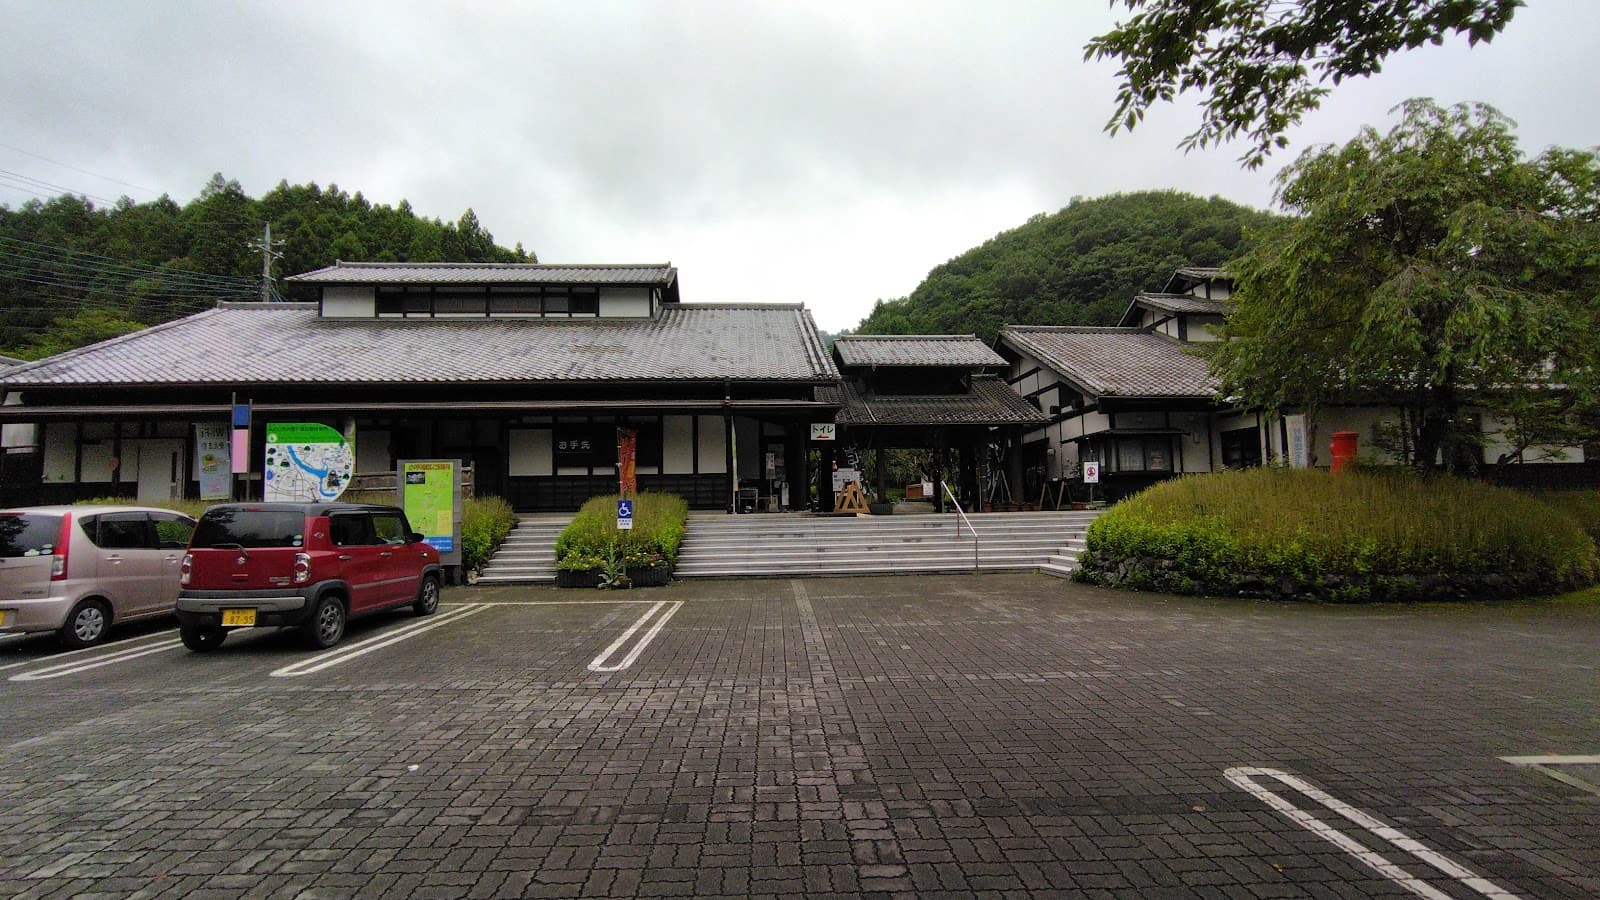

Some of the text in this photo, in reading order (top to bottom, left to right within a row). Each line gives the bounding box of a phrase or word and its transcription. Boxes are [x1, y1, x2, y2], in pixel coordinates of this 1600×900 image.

[813, 425, 834, 433] トイレ
[558, 440, 591, 449] お手洗
